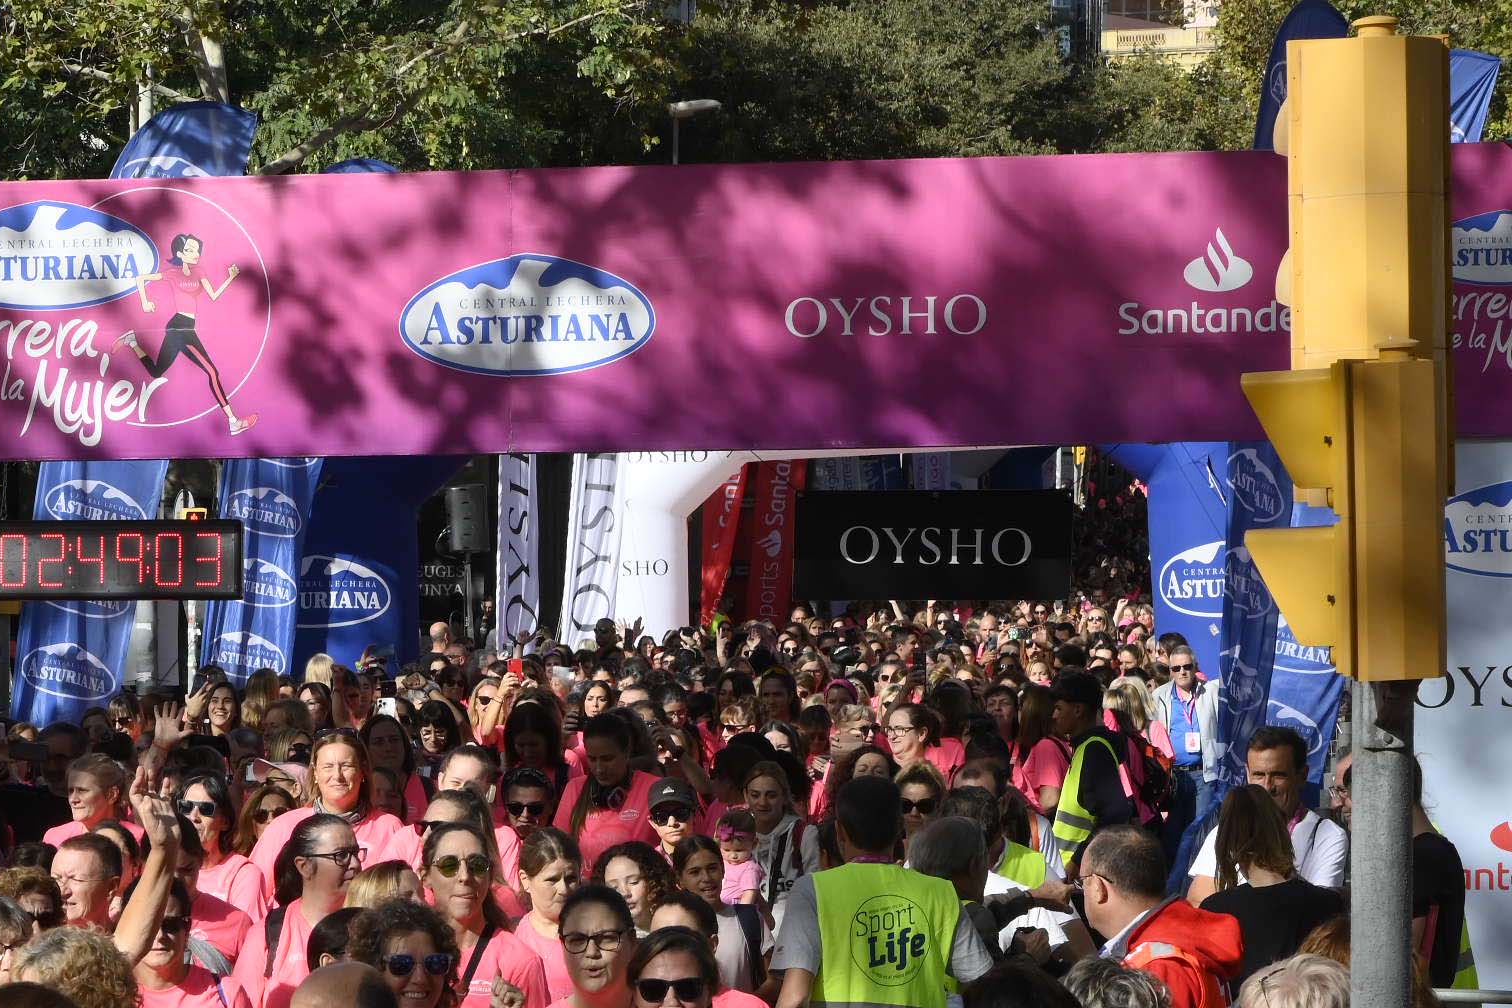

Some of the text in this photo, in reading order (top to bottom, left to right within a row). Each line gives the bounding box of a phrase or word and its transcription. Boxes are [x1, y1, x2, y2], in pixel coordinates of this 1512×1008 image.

[63, 237, 134, 249] LECHERA
[459, 295, 626, 310] CENTRAL LECHERA
[785, 294, 987, 338] OYSHO
[1119, 301, 1290, 335] Santande
[420, 301, 635, 345] ASTURIANA
[0, 361, 25, 401] la
[19, 352, 170, 446] Mujer
[53, 492, 140, 520] ASTURIAN
[231, 498, 296, 530] ASTURIAN
[506, 452, 538, 646] OYSH
[572, 453, 618, 631] OYSH
[839, 526, 1033, 566] OYSHO
[0, 533, 221, 588] 02:49:03
[623, 559, 668, 576] SHO
[1183, 568, 1225, 576] CENTRA
[300, 591, 381, 610] URIANA
[759, 561, 779, 623] ports
[1167, 575, 1225, 599] ASTU
[1276, 641, 1330, 665] URIAN
[28, 659, 106, 693] ASTURIANA
[856, 904, 915, 939] Sport
[868, 927, 926, 971] Life
